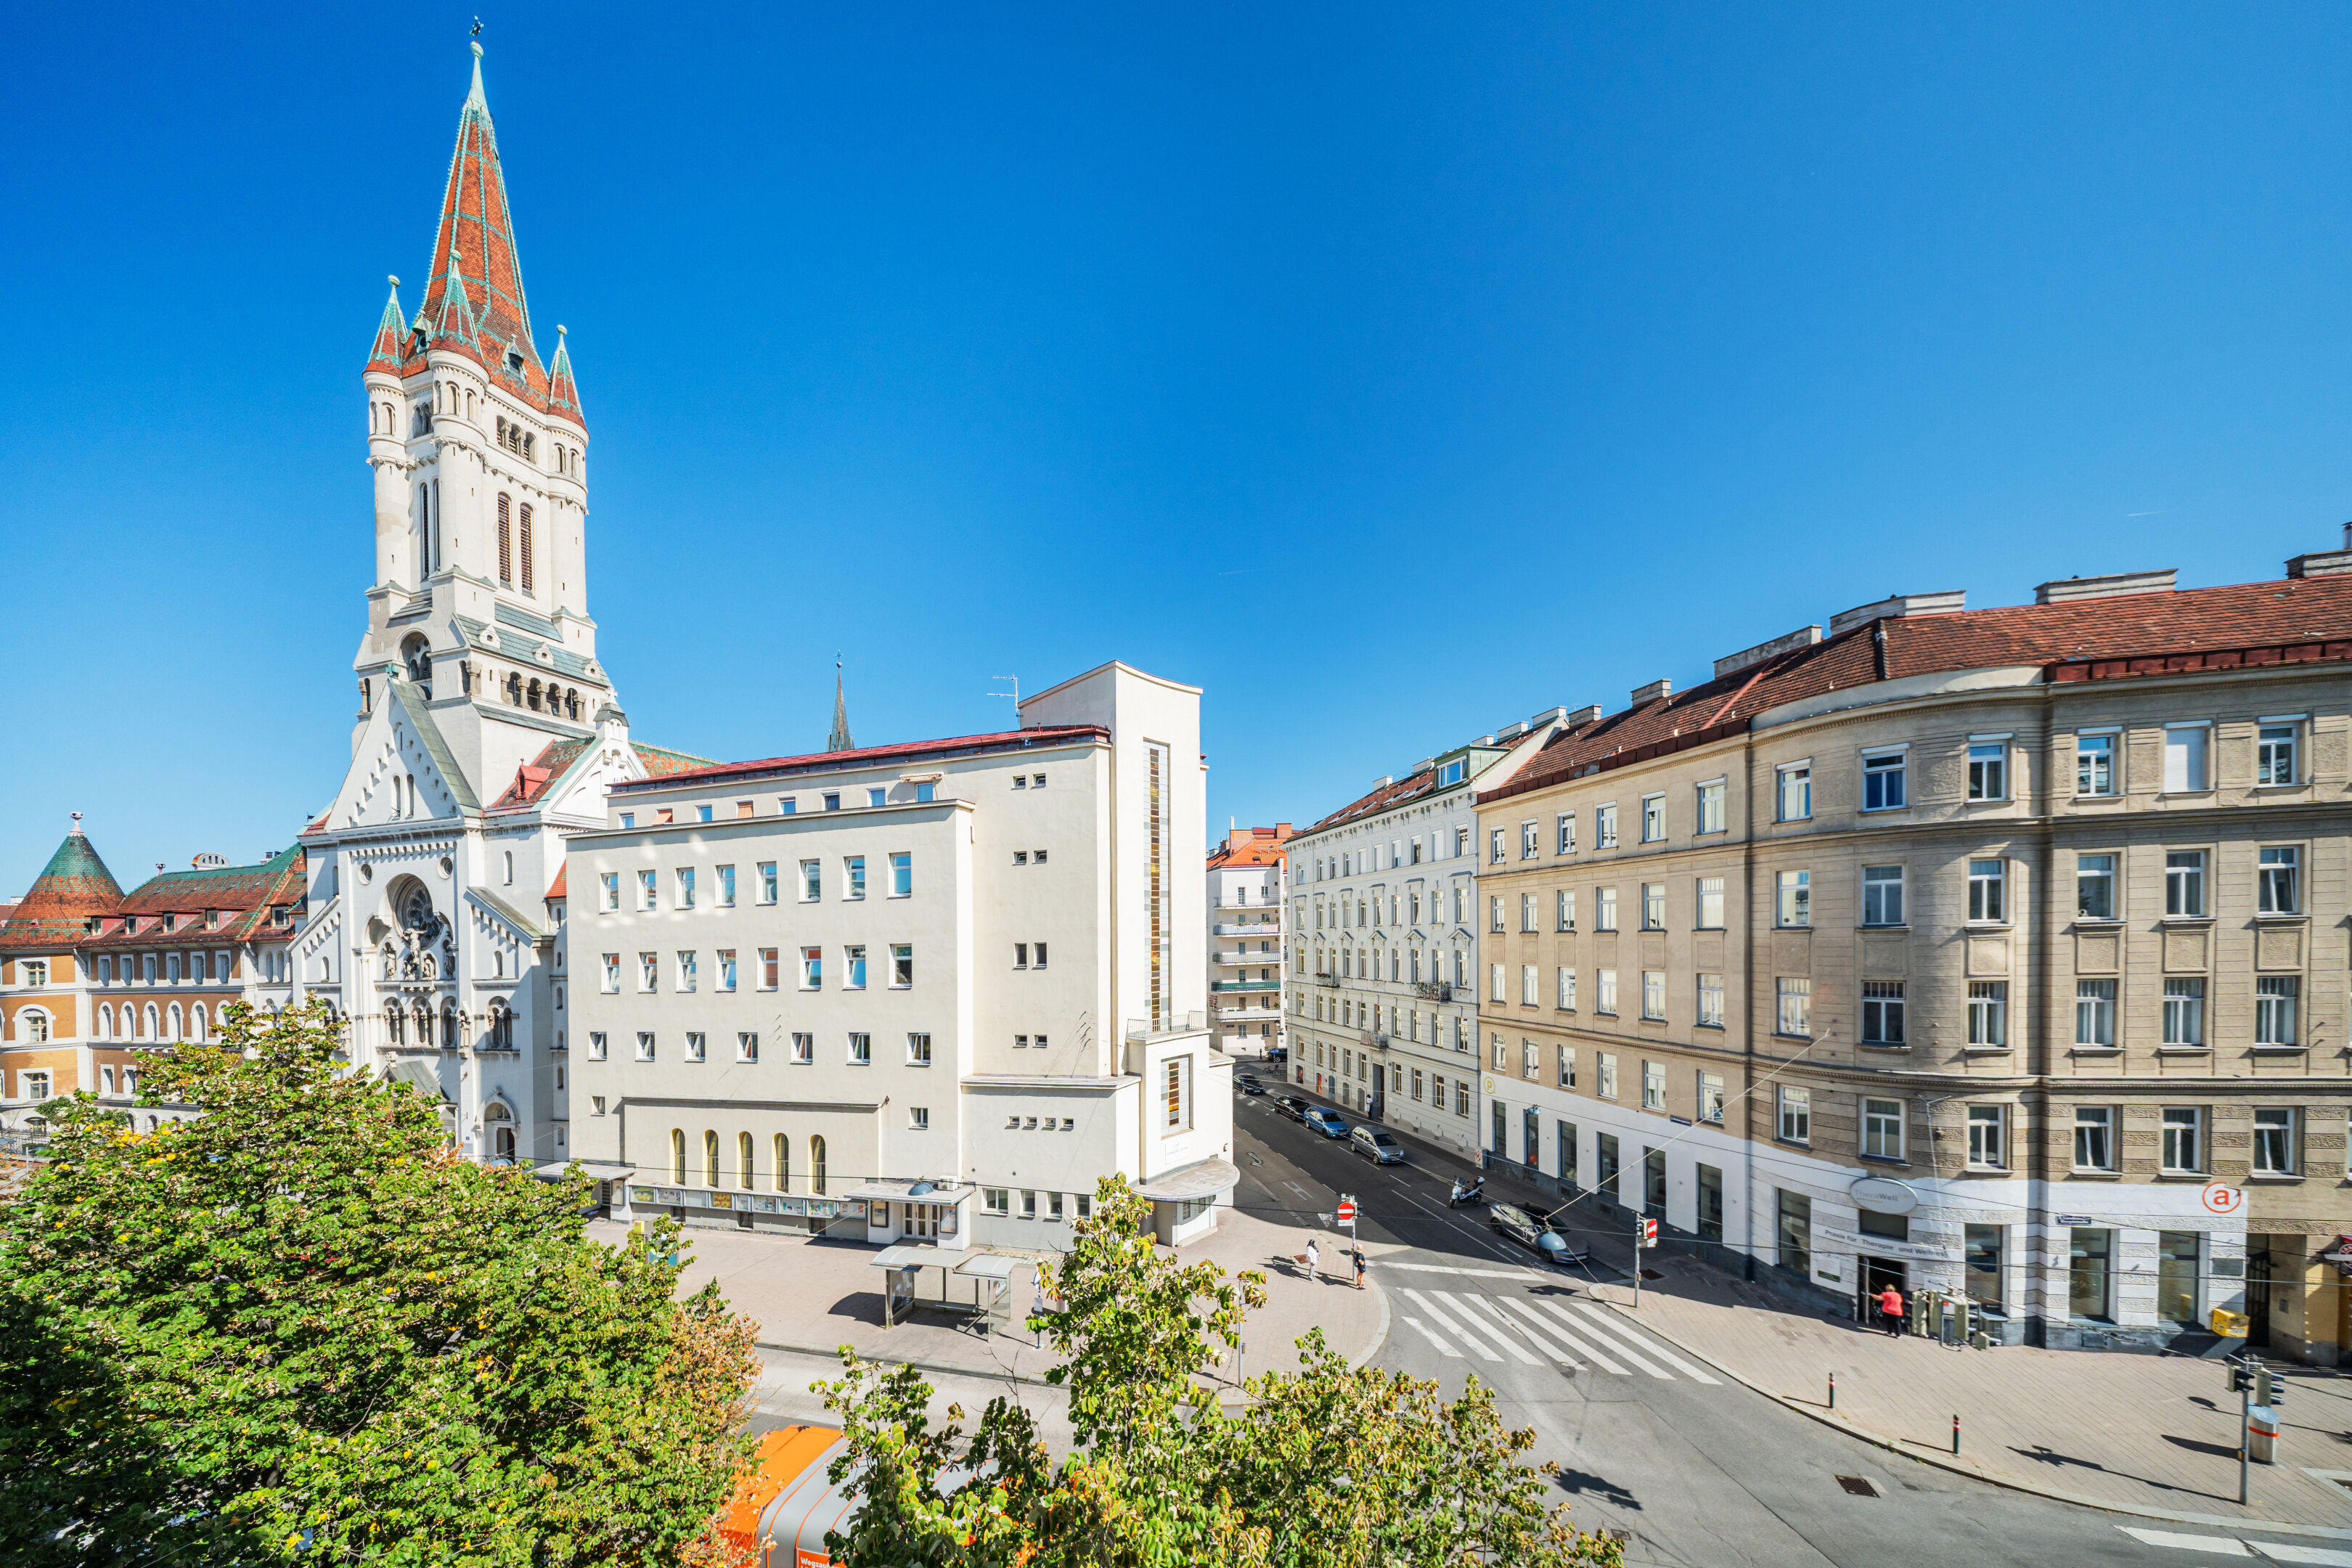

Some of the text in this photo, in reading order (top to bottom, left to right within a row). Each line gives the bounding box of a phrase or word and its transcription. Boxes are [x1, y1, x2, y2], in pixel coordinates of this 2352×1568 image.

[1855, 1189, 1899, 1202] TheraWell
[2213, 1189, 2230, 1206] a
[1825, 1229, 1845, 1240] Praxis
[1861, 1238, 1894, 1249] Therapie
